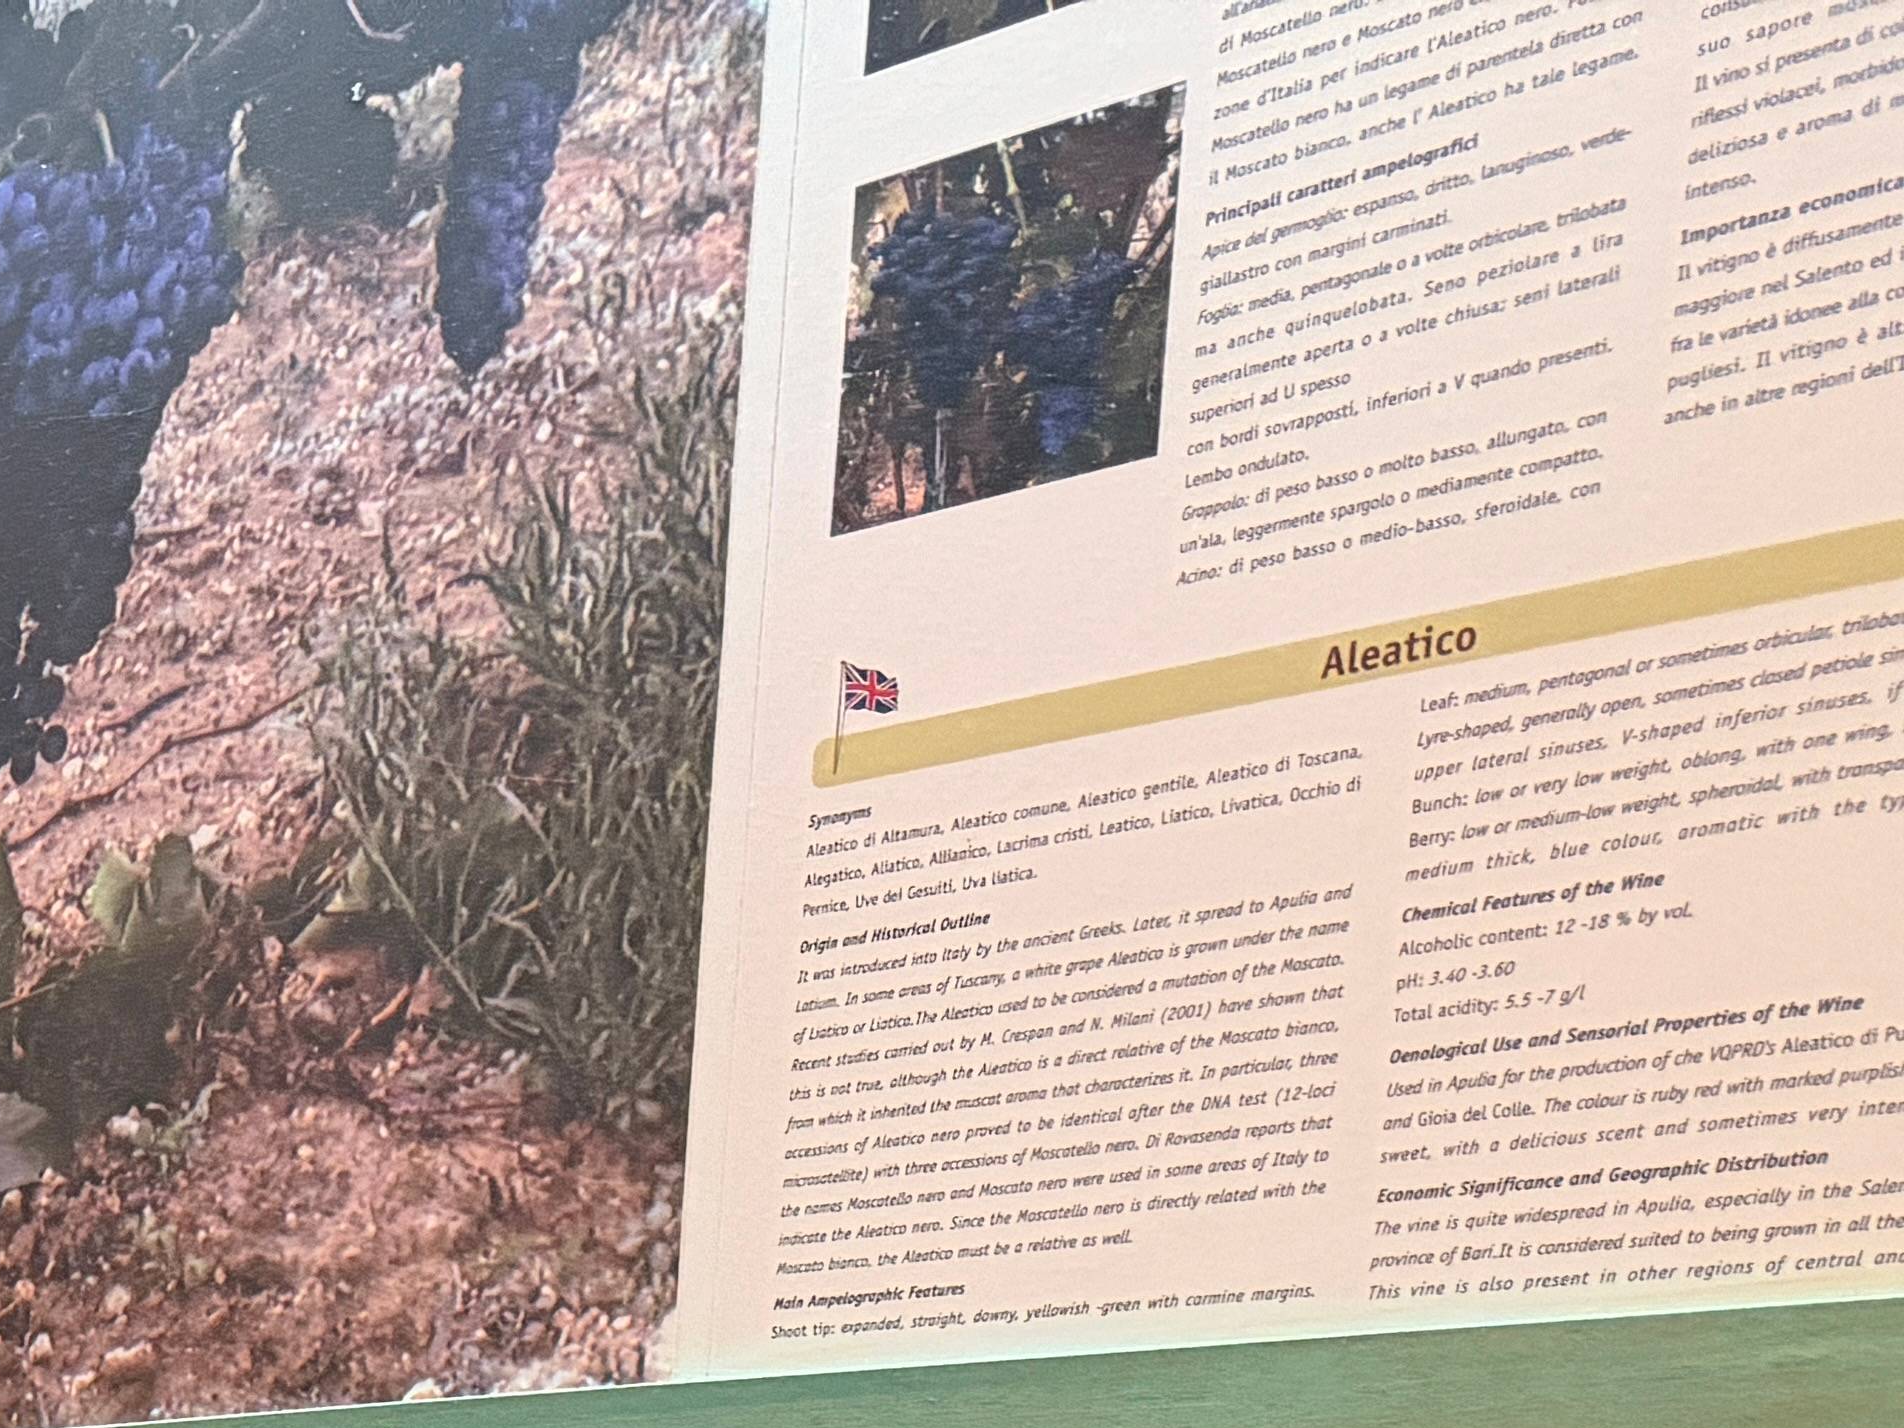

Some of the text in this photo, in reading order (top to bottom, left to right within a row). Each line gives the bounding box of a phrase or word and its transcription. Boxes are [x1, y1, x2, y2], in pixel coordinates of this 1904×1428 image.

[1210, 10, 1644, 154] Moscatello nero ha un legame di parentela diretta con
[1208, 168, 1219, 186] il
[1224, 152, 1289, 182] Moscato
[1294, 135, 1352, 161] bianco,
[1358, 117, 1407, 141] anche
[1427, 88, 1498, 121] Aleatico
[1503, 80, 1525, 98] ha
[1530, 67, 1566, 90] tale
[1572, 48, 1640, 78] legame.
[1205, 132, 1479, 228] Principali caratteri ampelografici
[1200, 208, 1453, 297] giallastro con margini carminati.
[1679, 206, 1793, 247] Importanza
[1194, 233, 1624, 359] ma anche quinquelobata. Seno peziolare a lira
[1191, 354, 1298, 395] generalmente
[1303, 338, 1355, 364] aperta
[1361, 334, 1372, 347] o
[1378, 329, 1389, 343] a
[1395, 317, 1439, 338] volte
[1513, 282, 1551, 308] seni
[1557, 264, 1621, 297] laterali
[1186, 337, 1615, 457] con bordi sovrapposti, inferiori a V quando presenti.
[1189, 372, 1352, 425] superiori ad U spesso
[1185, 449, 1310, 489] Lembo ondulato.
[1321, 625, 1477, 679] Aleatico
[807, 806, 873, 832] Synonyms
[1401, 872, 1666, 924] Chemical Features of the Wine
[799, 912, 992, 956] Origin and Historical Outline
[1398, 932, 1474, 958] Alcoholic
[1478, 923, 1549, 946] content:
[1555, 917, 1577, 936] 12
[1580, 912, 1612, 931] -18
[1616, 910, 1633, 927] %
[1637, 907, 1659, 928] by
[1393, 983, 1586, 1023] Total acidity: 5.5 -7 g/l
[1395, 960, 1518, 995] pH: 3.40 -3.60
[1389, 995, 1866, 1065] Oenological Use and Sensorial Properties of the Wine
[1376, 1149, 1829, 1205] Economic Significance and Geographic Distribution
[773, 1284, 966, 1314] Main Ampelographic Features
